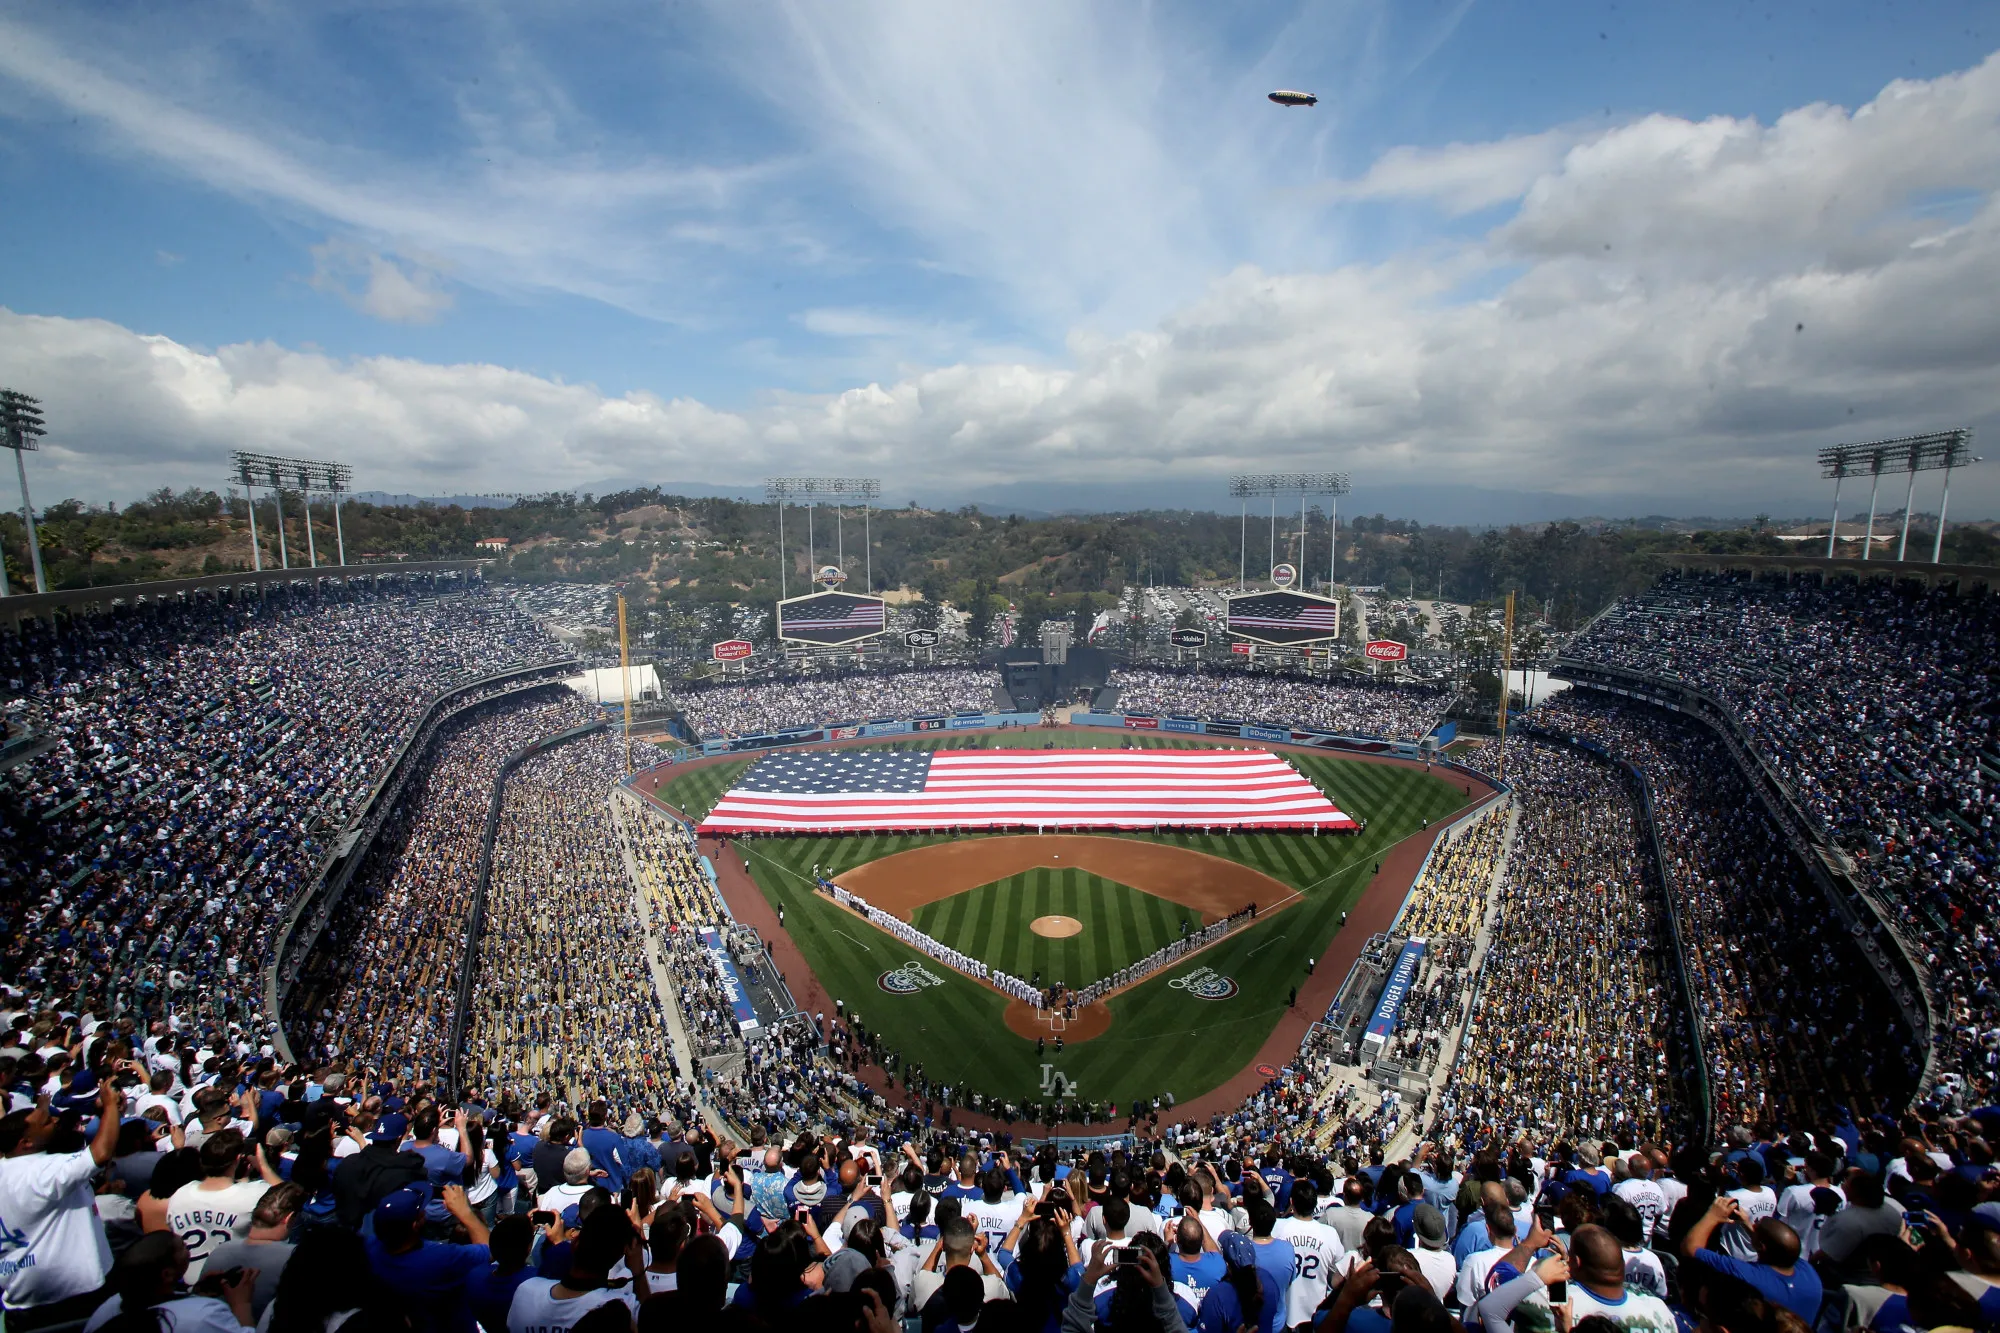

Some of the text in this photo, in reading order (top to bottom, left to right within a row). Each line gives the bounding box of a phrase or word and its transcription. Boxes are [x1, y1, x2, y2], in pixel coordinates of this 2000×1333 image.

[929, 721, 939, 729] LG
[1249, 730, 1281, 739] @Dodgers
[904, 961, 946, 986] Opening
[1168, 966, 1213, 989] Opening
[1379, 952, 1417, 1019] DODGER STADIUM
[1040, 1064, 1077, 1097] LA
[1749, 1202, 1775, 1215] ETHIER
[174, 1210, 238, 1229] GIBSON
[980, 1216, 1003, 1230] CRUZ
